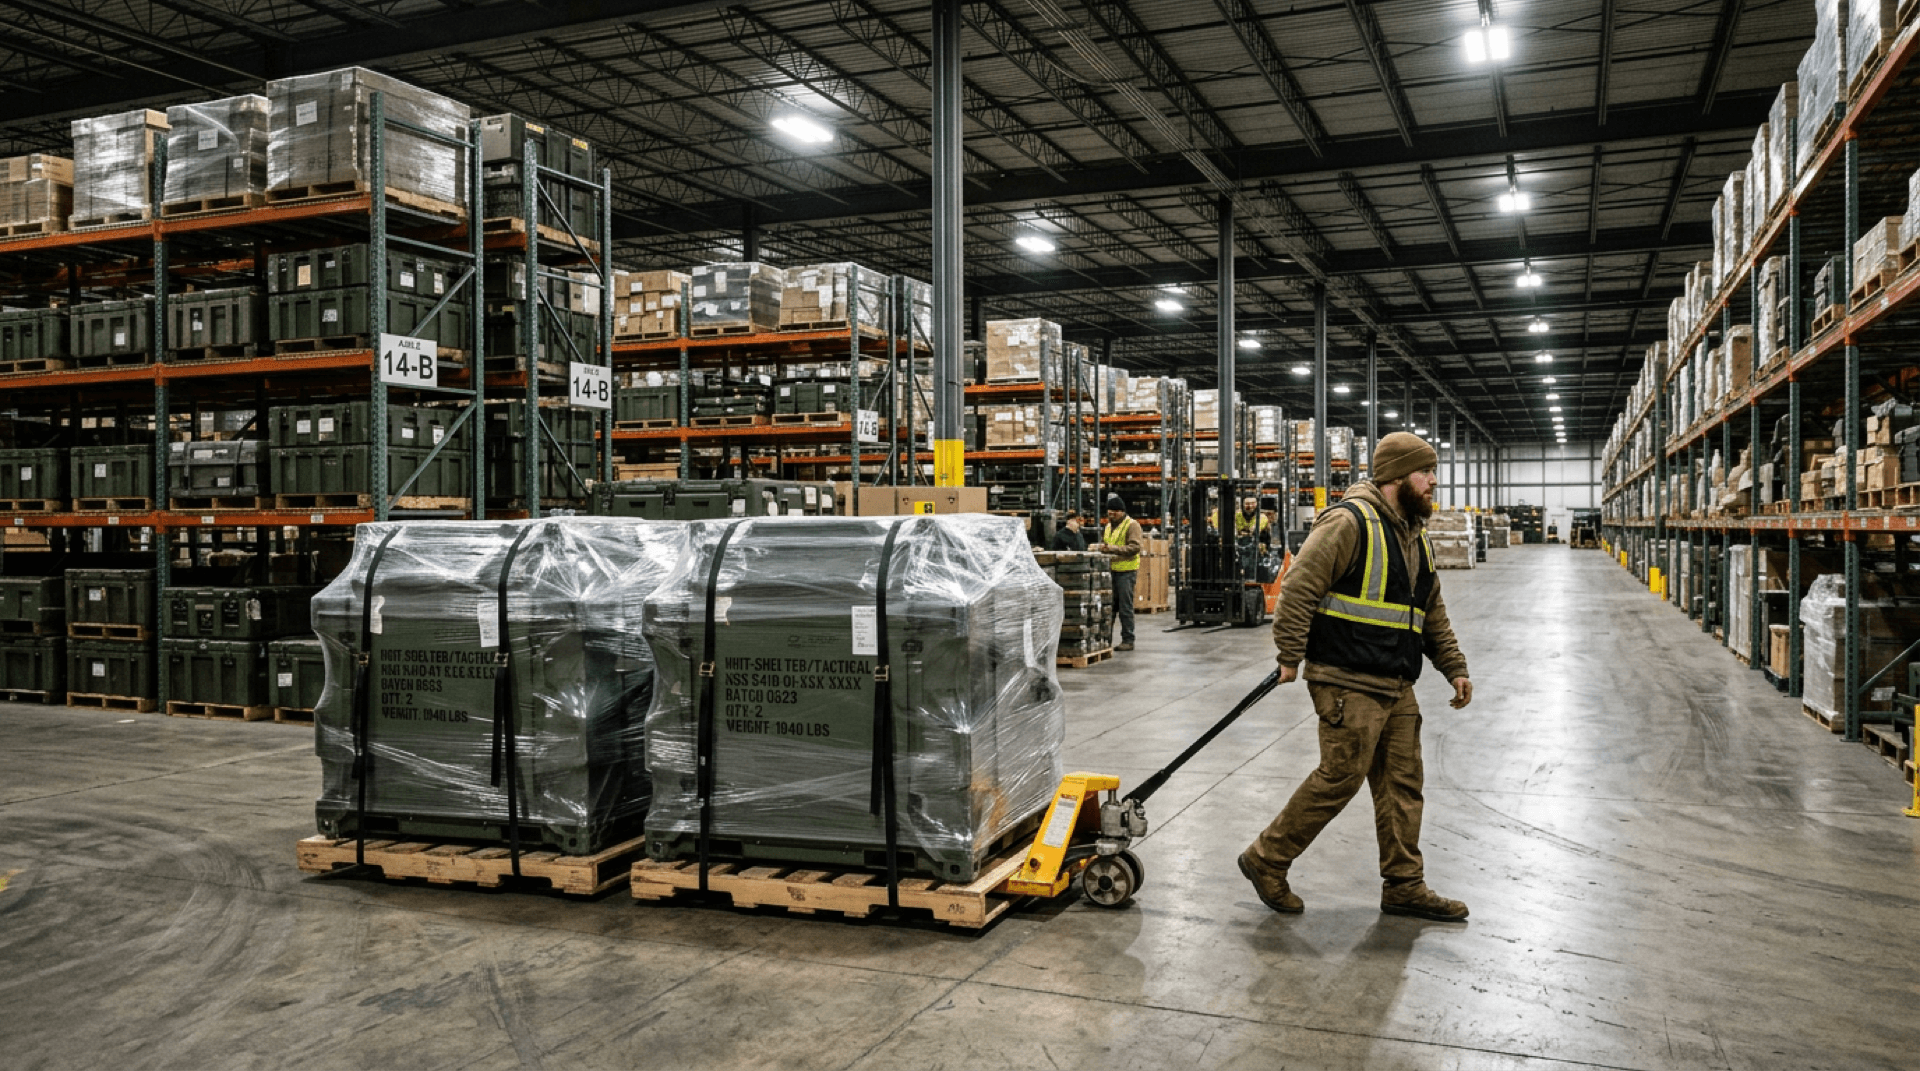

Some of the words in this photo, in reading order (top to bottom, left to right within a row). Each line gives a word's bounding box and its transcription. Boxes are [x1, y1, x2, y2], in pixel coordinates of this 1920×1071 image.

[384, 350, 433, 380] 14-B
[573, 376, 609, 402] 14-B
[405, 693, 413, 705] 2
[807, 722, 830, 737] LBS
